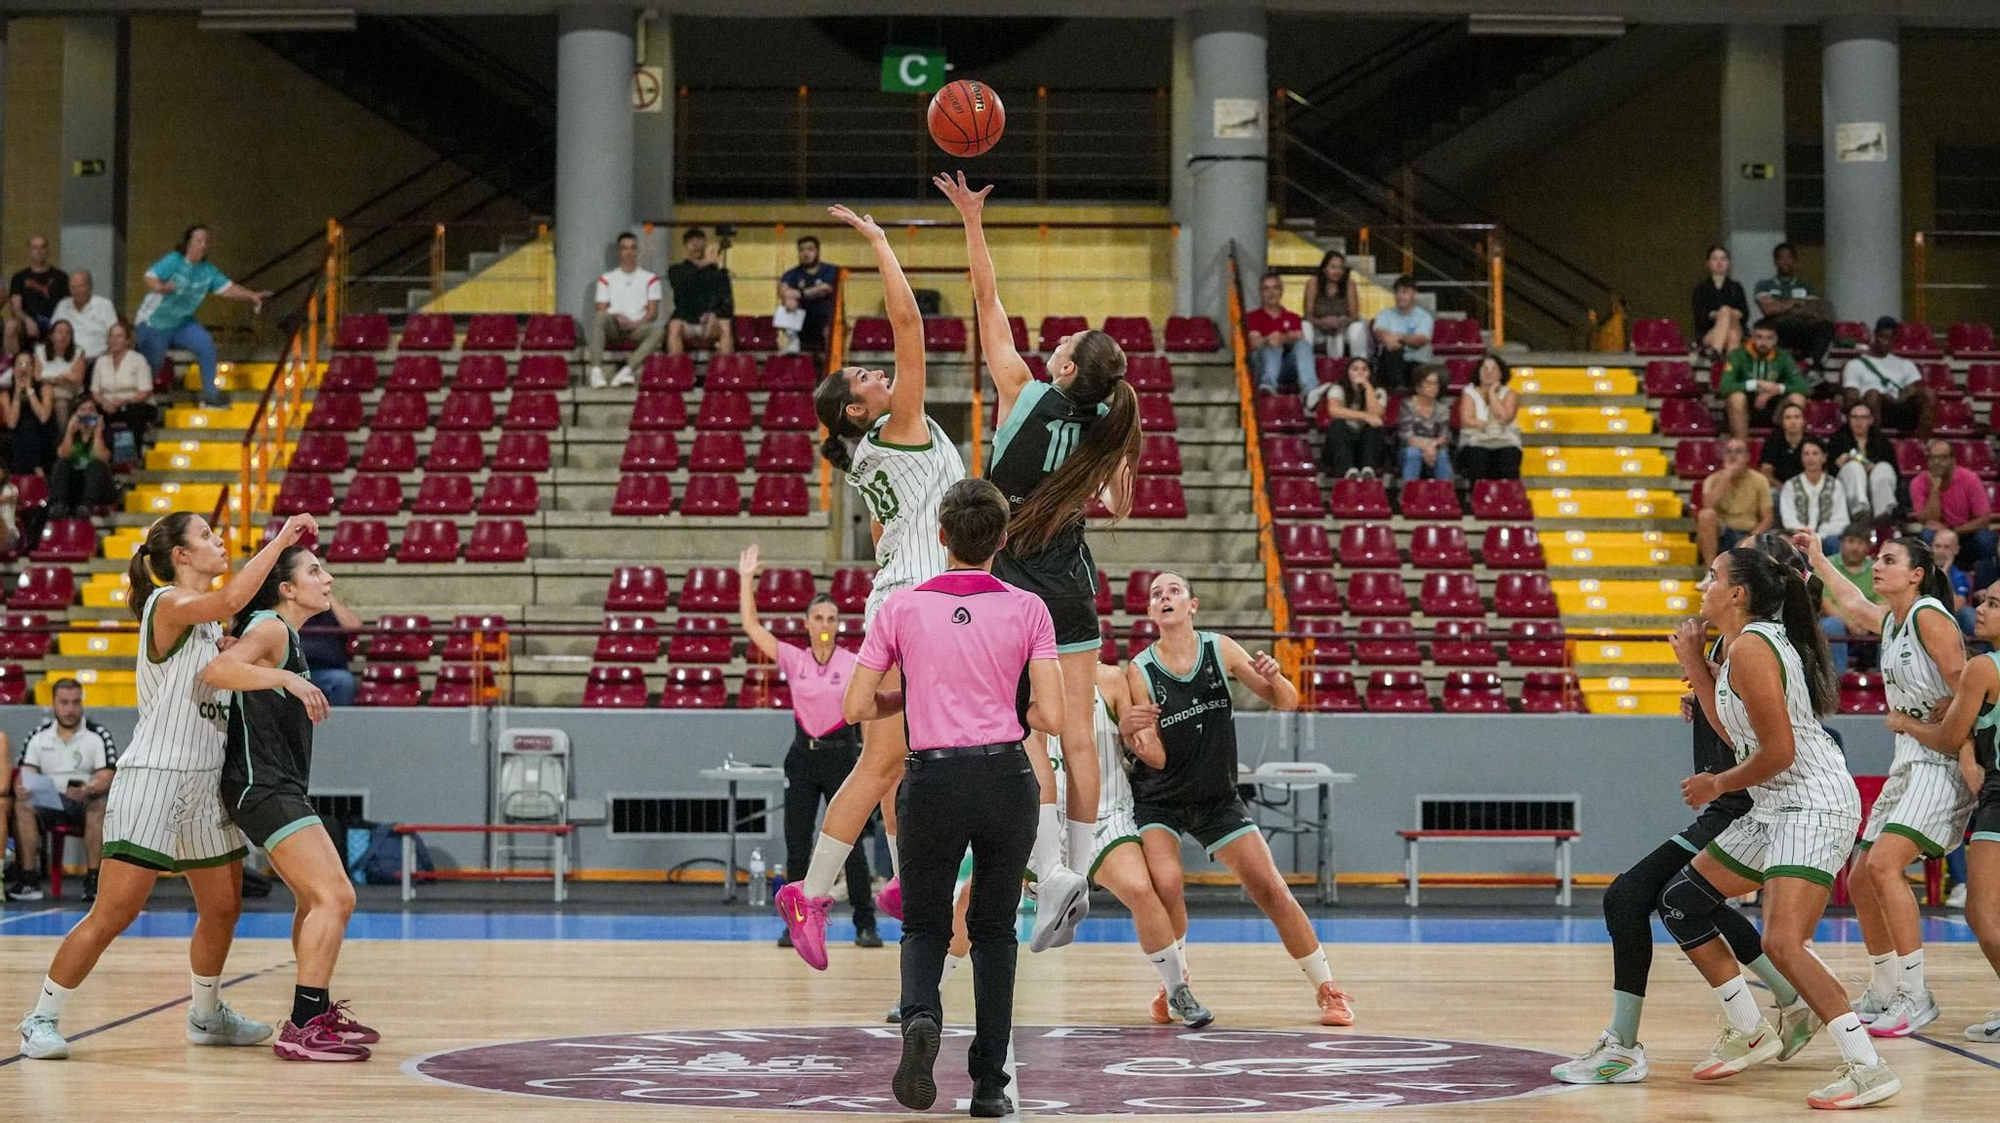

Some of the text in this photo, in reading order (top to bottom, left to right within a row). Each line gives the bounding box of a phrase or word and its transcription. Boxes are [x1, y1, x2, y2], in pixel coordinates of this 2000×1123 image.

[899, 54, 928, 87] C
[1042, 419, 1081, 472] 10
[1195, 723, 1203, 735] 7
